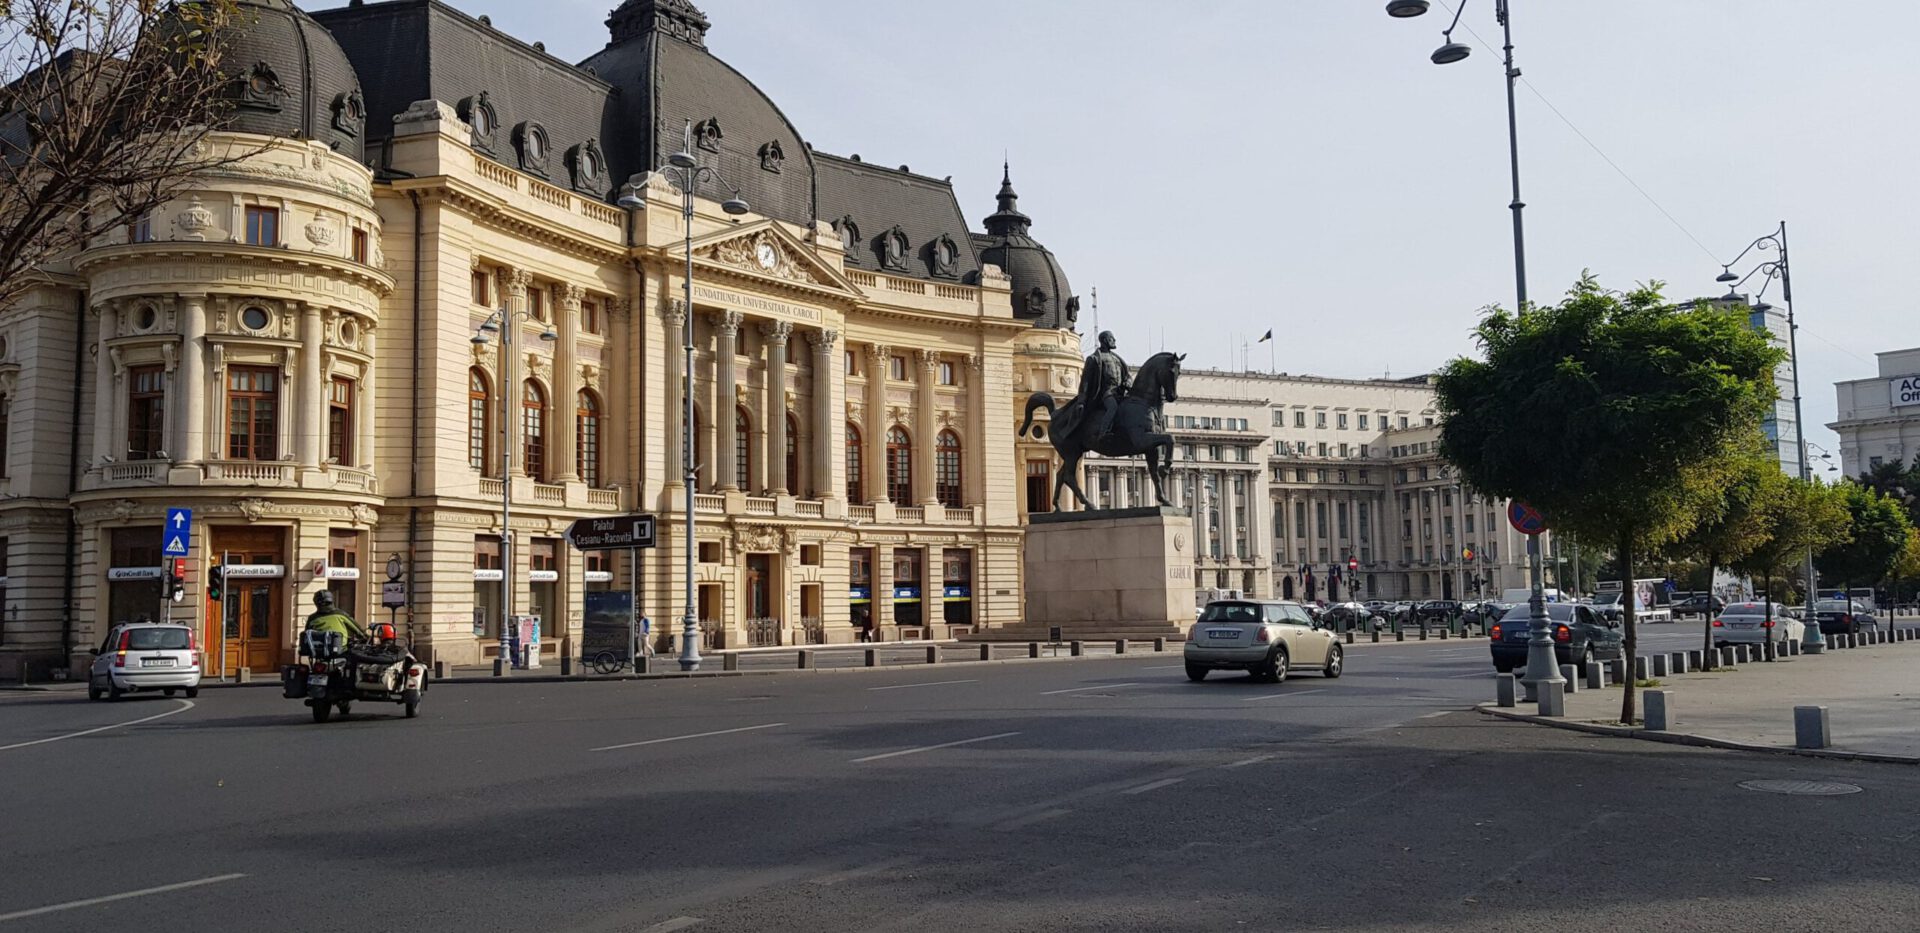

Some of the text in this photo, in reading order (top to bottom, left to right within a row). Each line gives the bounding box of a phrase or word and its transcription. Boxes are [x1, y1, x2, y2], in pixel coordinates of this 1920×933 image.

[694, 286, 741, 305] FUNDATIUNEA
[743, 298, 791, 315] UNIVERSITARA
[793, 306, 815, 320] CAROL
[593, 519, 616, 531] Palatul
[122, 570, 142, 578] UniCredit
[231, 567, 275, 575] UniCredit Bank
